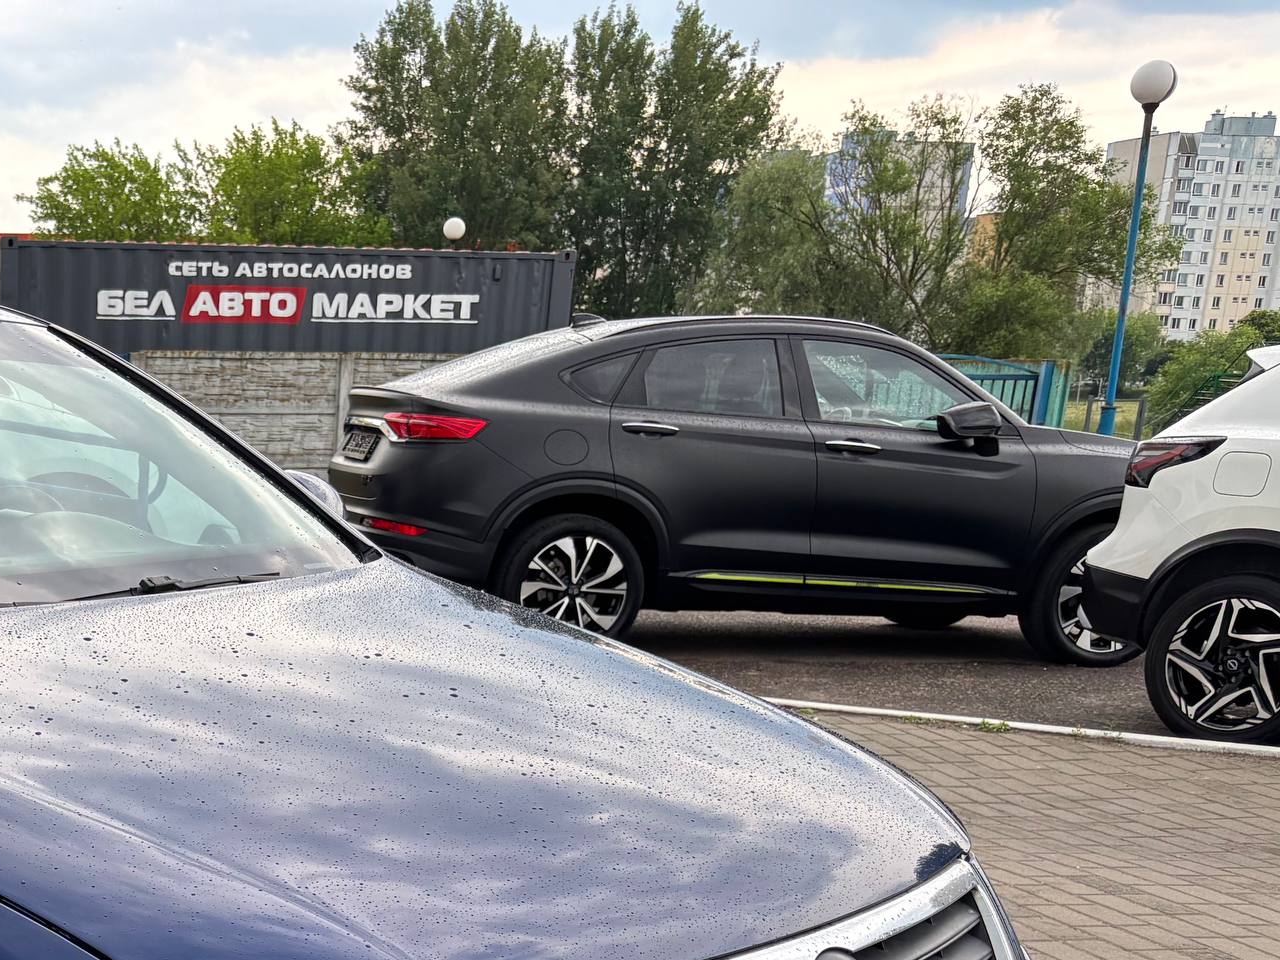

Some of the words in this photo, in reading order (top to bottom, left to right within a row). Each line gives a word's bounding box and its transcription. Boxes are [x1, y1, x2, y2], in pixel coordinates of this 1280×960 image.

[168, 261, 229, 277] СЕТЬ
[234, 262, 412, 280] АВТОСАЛОНОВ
[97, 290, 176, 316] БЕЛ
[188, 291, 297, 317] АВТО
[312, 292, 480, 319] МАРКЕТ
